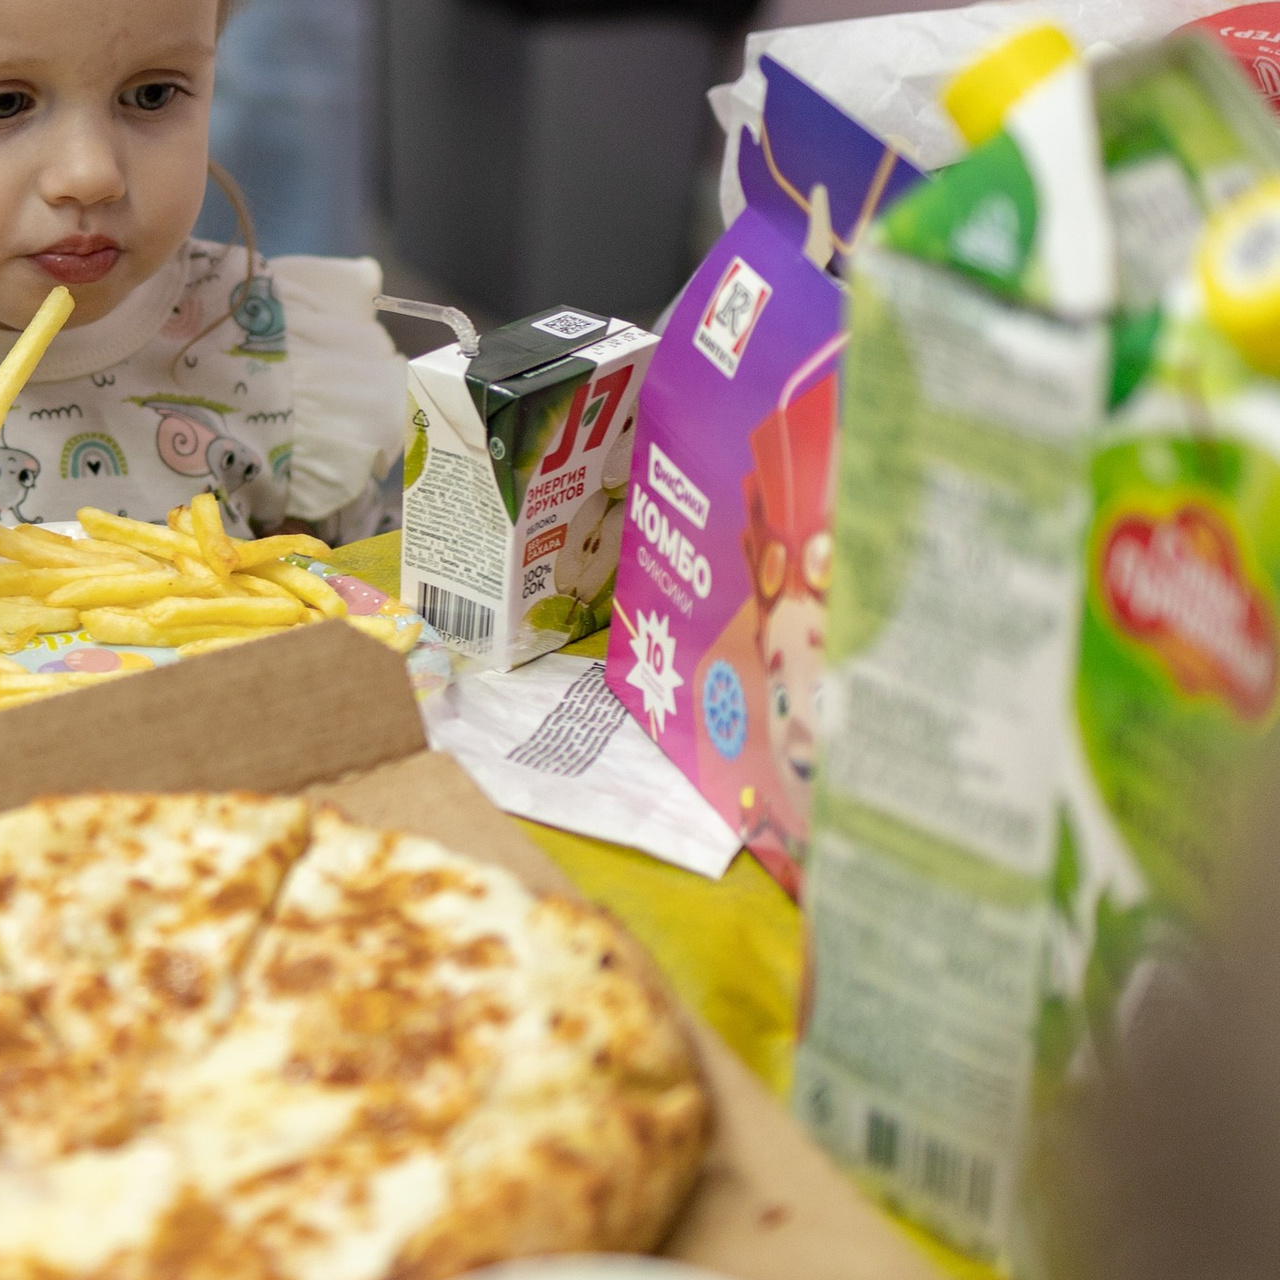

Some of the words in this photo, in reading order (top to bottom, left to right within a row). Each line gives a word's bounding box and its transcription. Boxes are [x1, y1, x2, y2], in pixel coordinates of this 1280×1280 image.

[540, 363, 635, 477] J7
[526, 482, 585, 520] ФРУКТОВ
[527, 465, 587, 503] ЭНЕРГИЯ
[526, 514, 557, 537] ЯБЛОКО
[630, 482, 712, 599] КОМБО
[527, 537, 562, 562] САХАРА
[522, 577, 546, 600] СОК
[523, 563, 552, 587] 100%
[645, 630, 664, 676] 10
